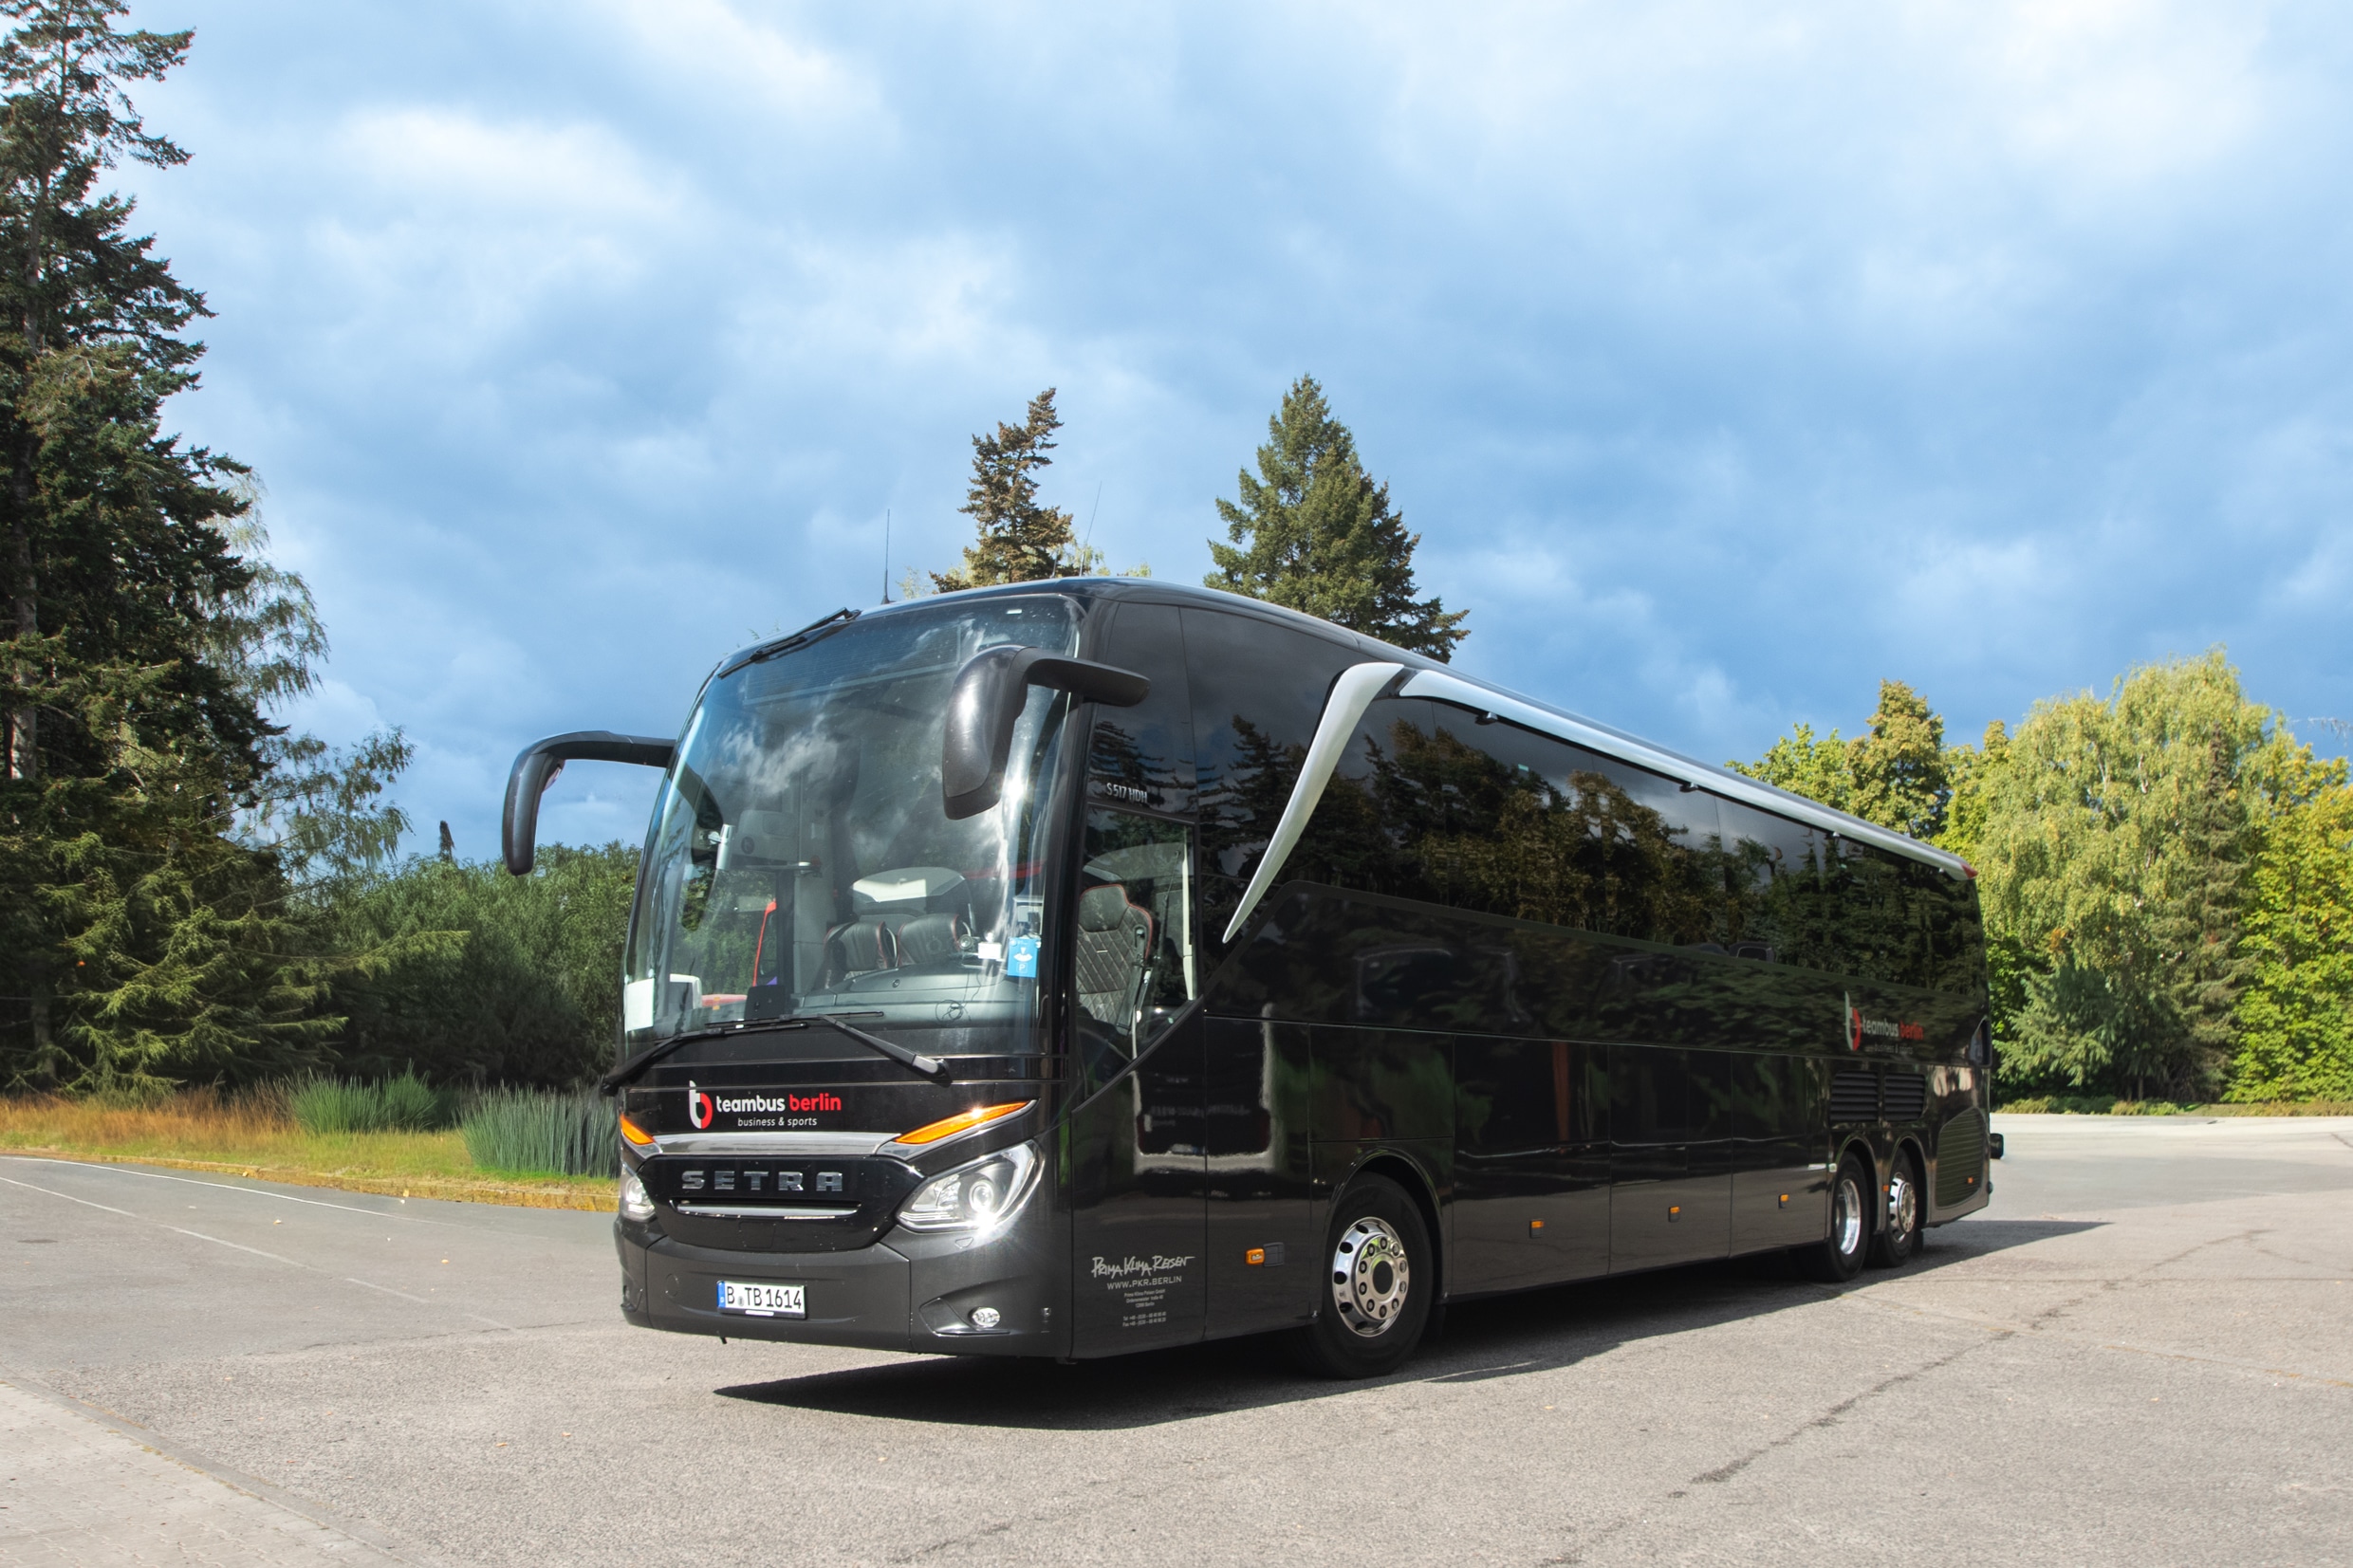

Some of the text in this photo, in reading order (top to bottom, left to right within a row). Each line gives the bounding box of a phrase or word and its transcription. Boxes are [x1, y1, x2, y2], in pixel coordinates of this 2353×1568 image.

[1106, 782, 1148, 803] S 517 HDH
[1862, 1014, 1924, 1041] teambus berlin
[715, 1093, 842, 1113] teambus berlin
[737, 1116, 817, 1128] business & sports
[681, 1171, 843, 1191] SETRA
[1106, 1275, 1182, 1290] WWW.PKR.BERLIN
[727, 1285, 735, 1304] B
